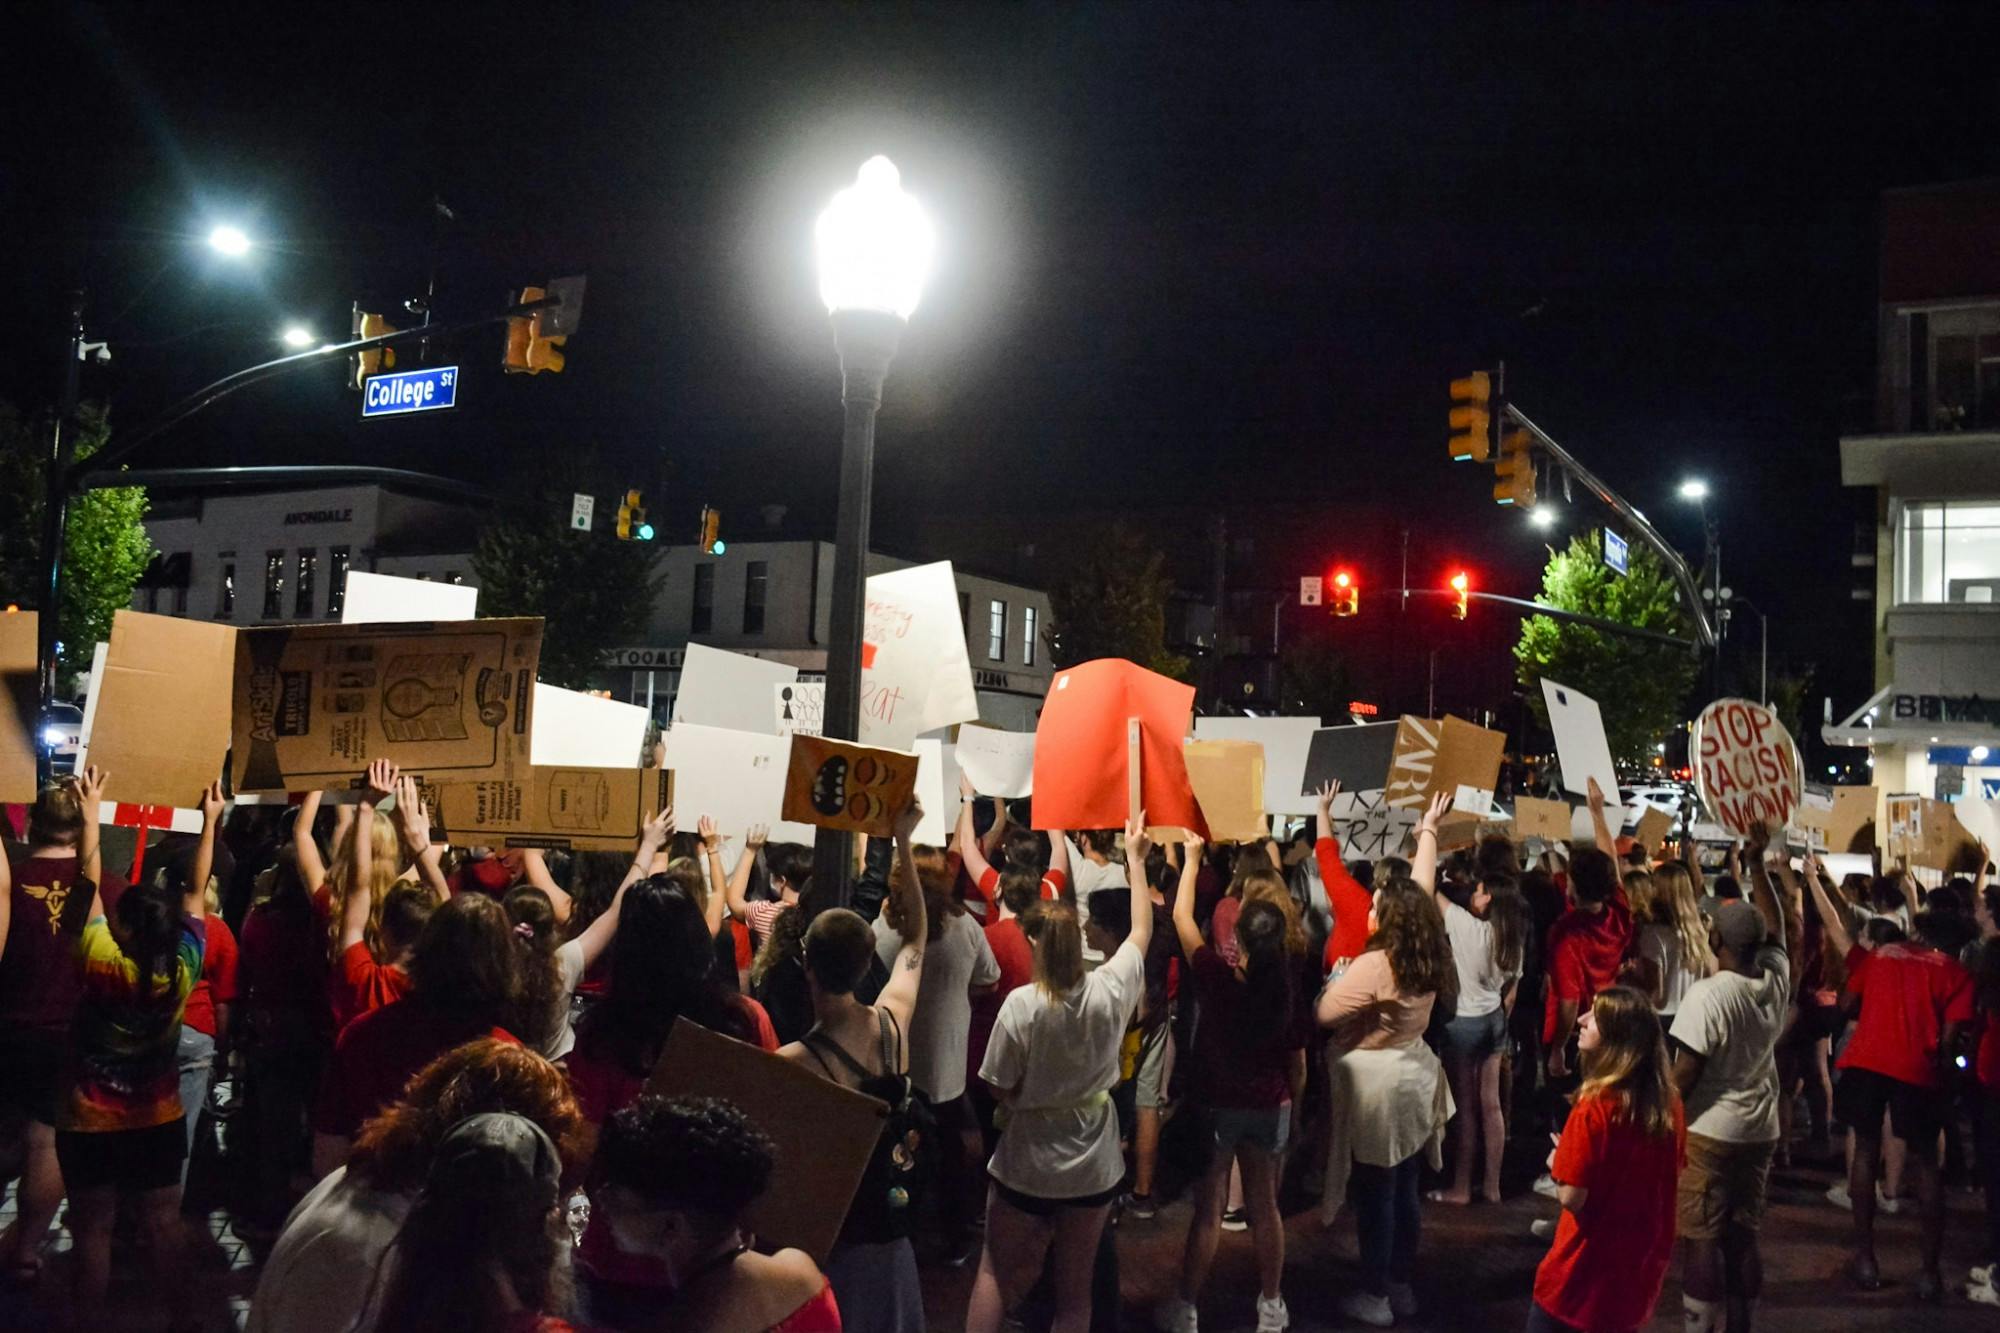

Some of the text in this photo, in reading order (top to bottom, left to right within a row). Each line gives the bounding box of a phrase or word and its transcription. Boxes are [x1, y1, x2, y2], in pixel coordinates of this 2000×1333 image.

[368, 372, 453, 408] College St
[284, 508, 353, 525] AVONDALE
[615, 650, 685, 666] TOOME
[1701, 704, 1772, 757] STOP
[476, 794, 486, 824] Great
